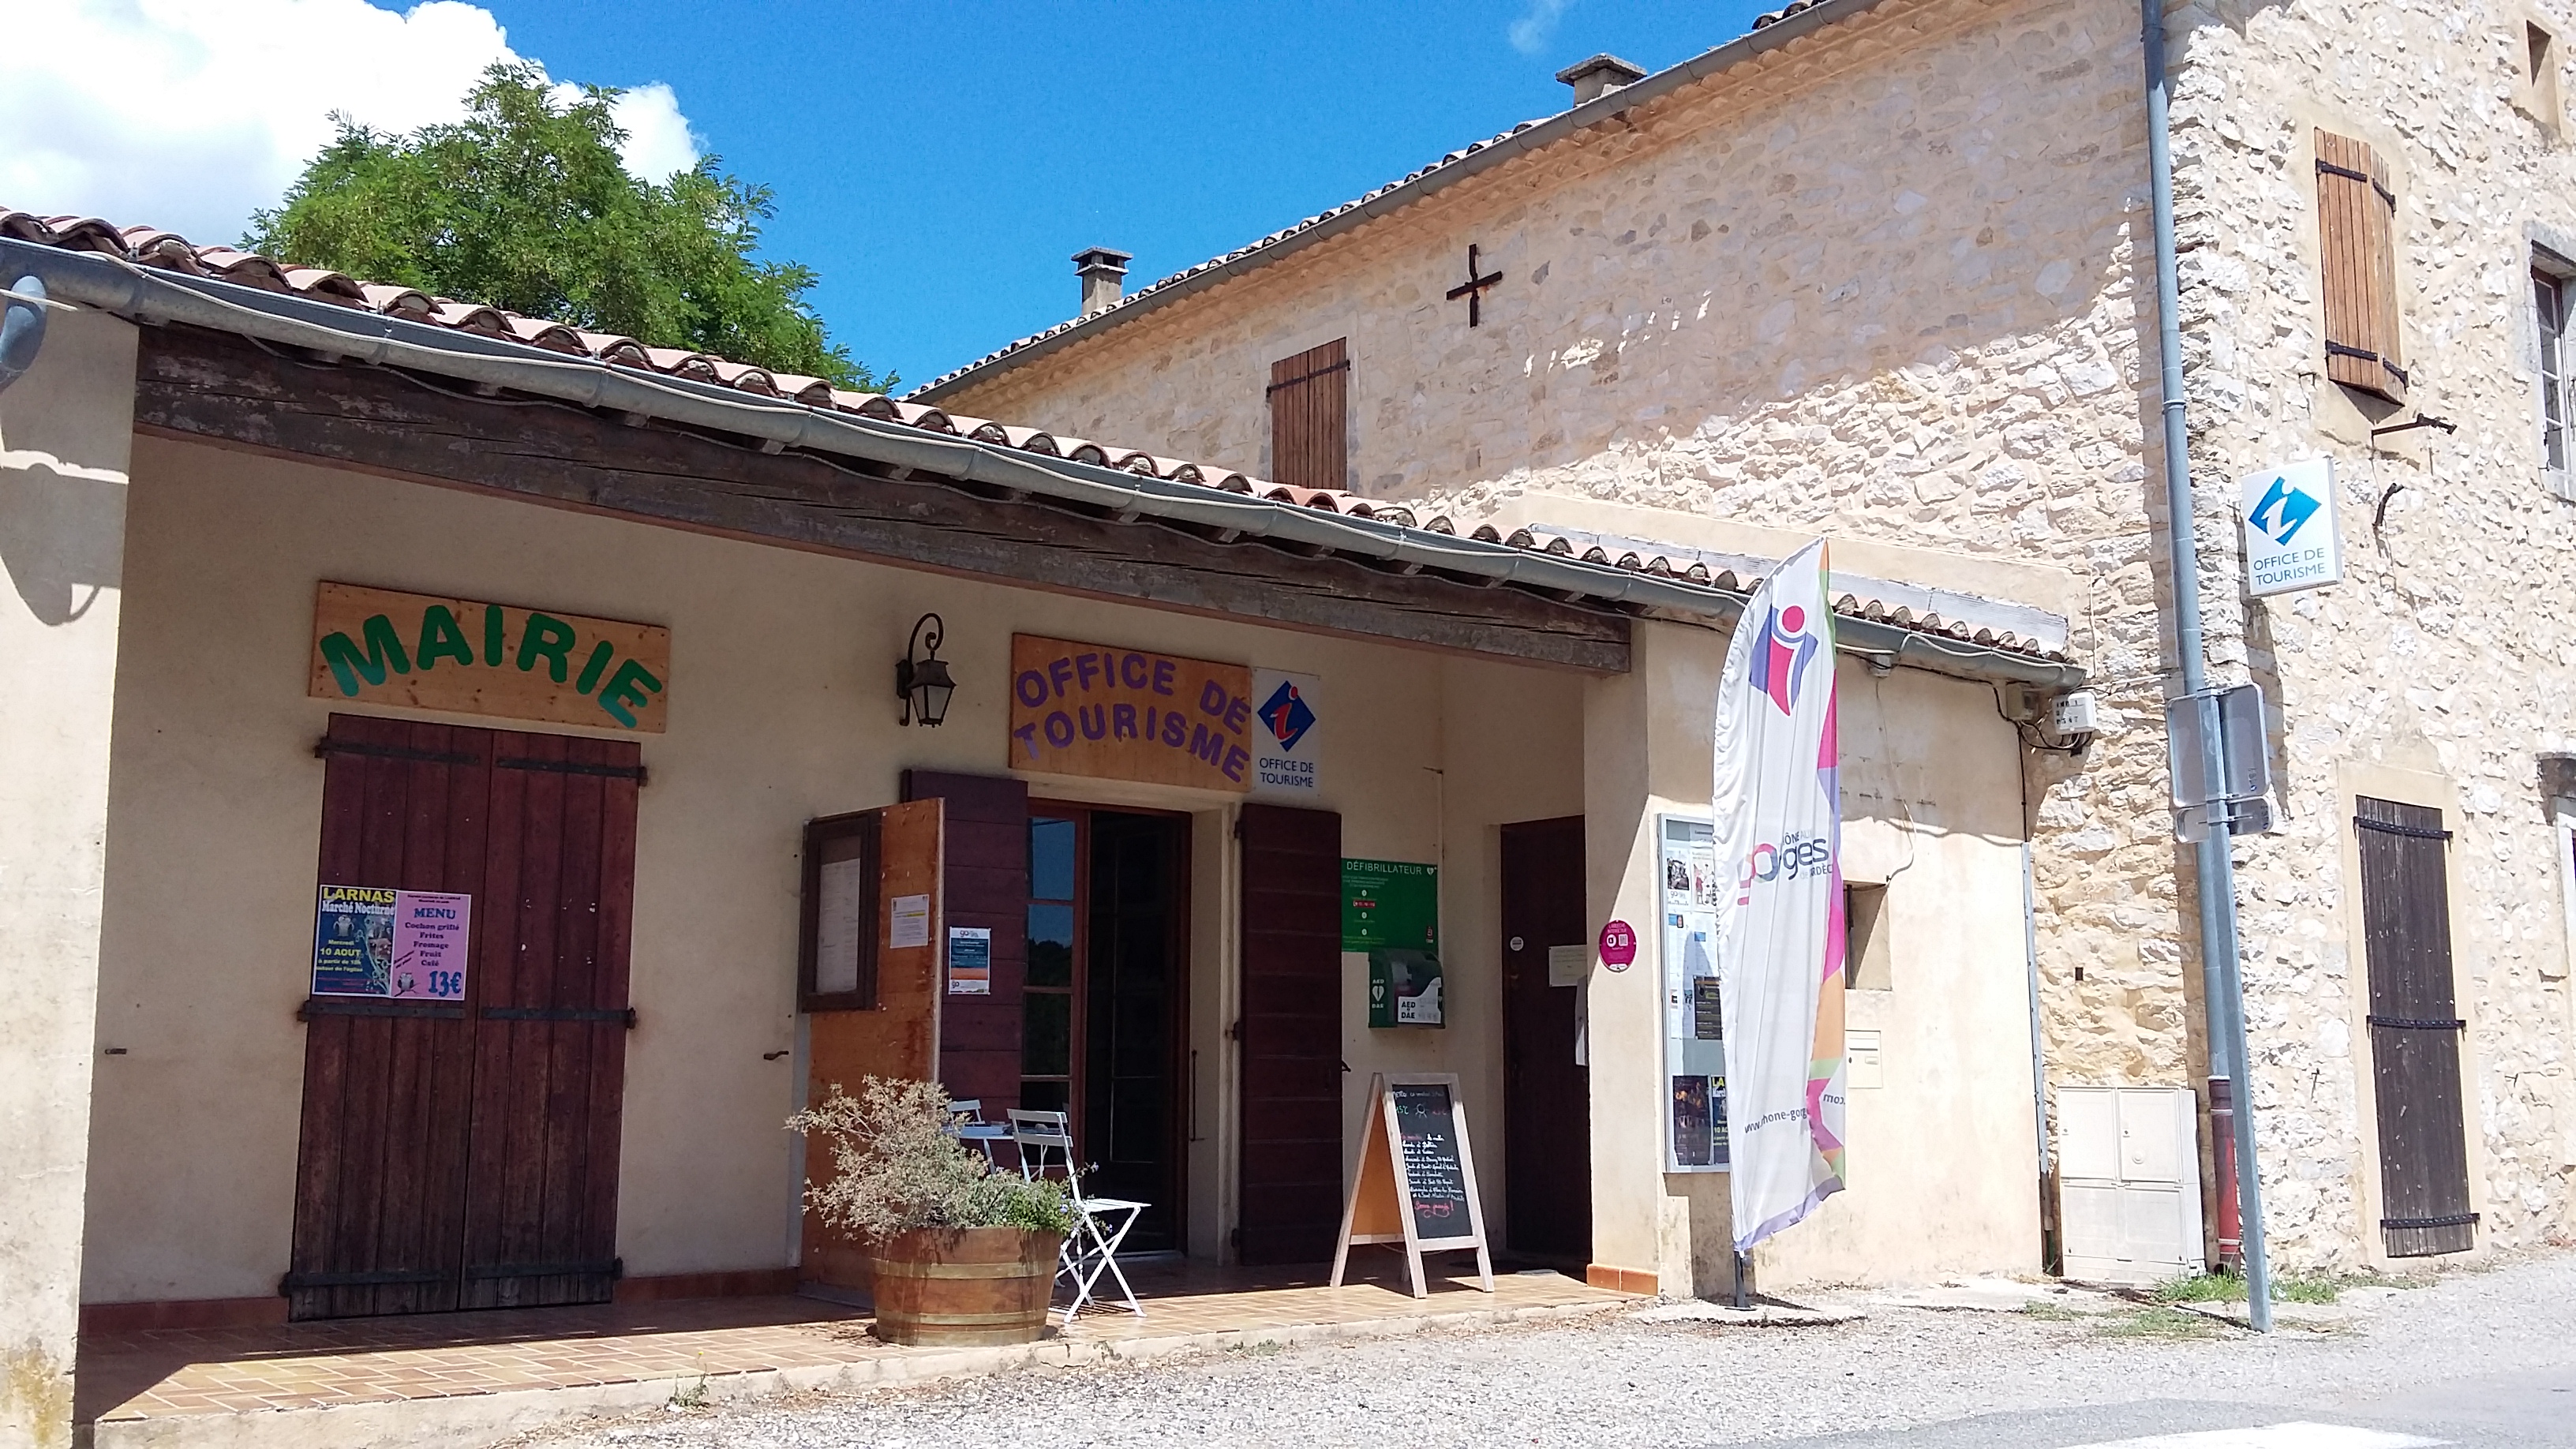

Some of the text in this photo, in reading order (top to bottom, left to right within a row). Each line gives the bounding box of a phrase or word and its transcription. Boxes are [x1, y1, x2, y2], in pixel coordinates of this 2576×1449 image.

[2253, 547, 2325, 571] OFFICE DE
[2256, 563, 2326, 586] TOURISME
[320, 605, 663, 728] MAIRIE
[1016, 653, 1252, 736] OFFICE DE
[1013, 703, 1251, 783] TOURISME
[1260, 758, 1314, 774] OFFICE DE
[1260, 772, 1314, 788] TOURISME
[1346, 860, 1422, 875] DÉFIBRILLATEUR
[323, 887, 395, 904] LARNAS
[321, 900, 395, 915] Marché Nocturne
[414, 908, 456, 919] MENU
[320, 947, 362, 957] 10 AOUT
[413, 941, 449, 949] Fromage
[429, 971, 462, 997] 13€
